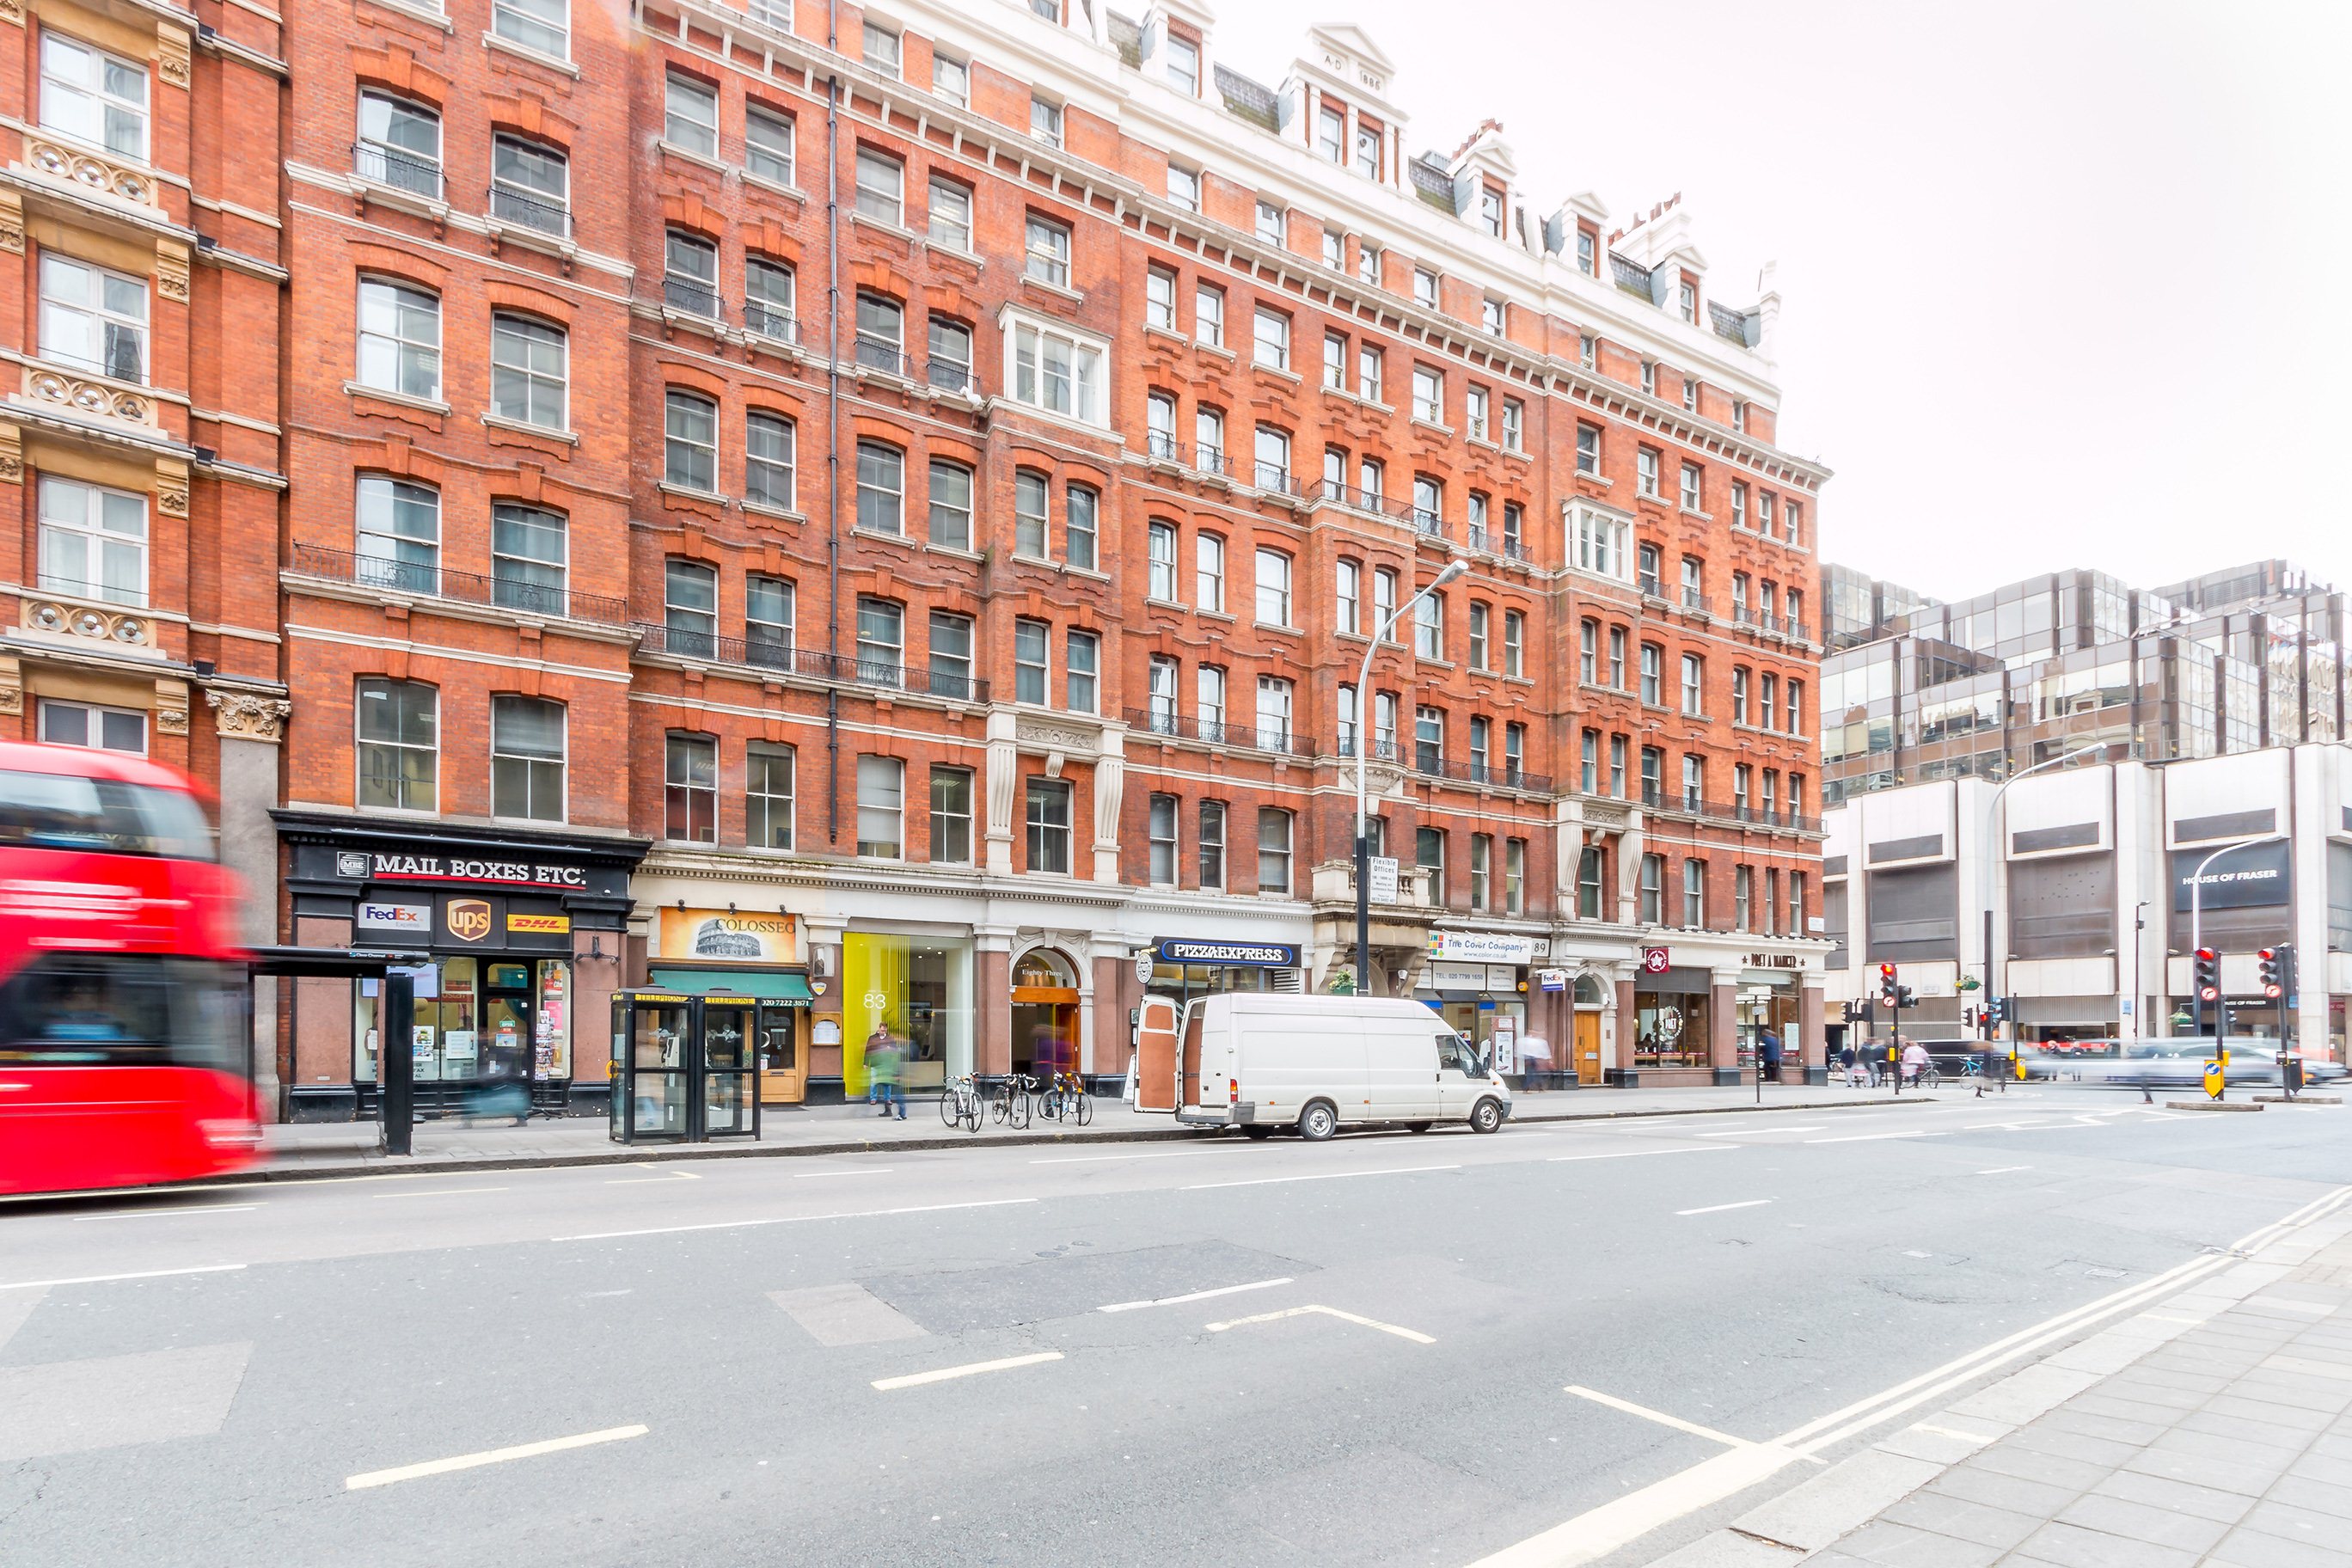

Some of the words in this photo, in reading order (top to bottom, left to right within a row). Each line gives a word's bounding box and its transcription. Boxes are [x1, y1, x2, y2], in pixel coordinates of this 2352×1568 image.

[375, 854, 444, 875] MAIL
[450, 860, 530, 881] BOXES
[536, 866, 586, 885] ETC.
[2219, 873, 2235, 882] OF
[2237, 870, 2277, 880] FRASER
[366, 906, 418, 922] FedEx
[451, 911, 488, 934] ups
[514, 918, 560, 928] DHL
[715, 918, 796, 934] COLOSSEO
[1488, 941, 1524, 952] Company
[1534, 942, 1546, 952] 89
[864, 993, 885, 1009] 83
